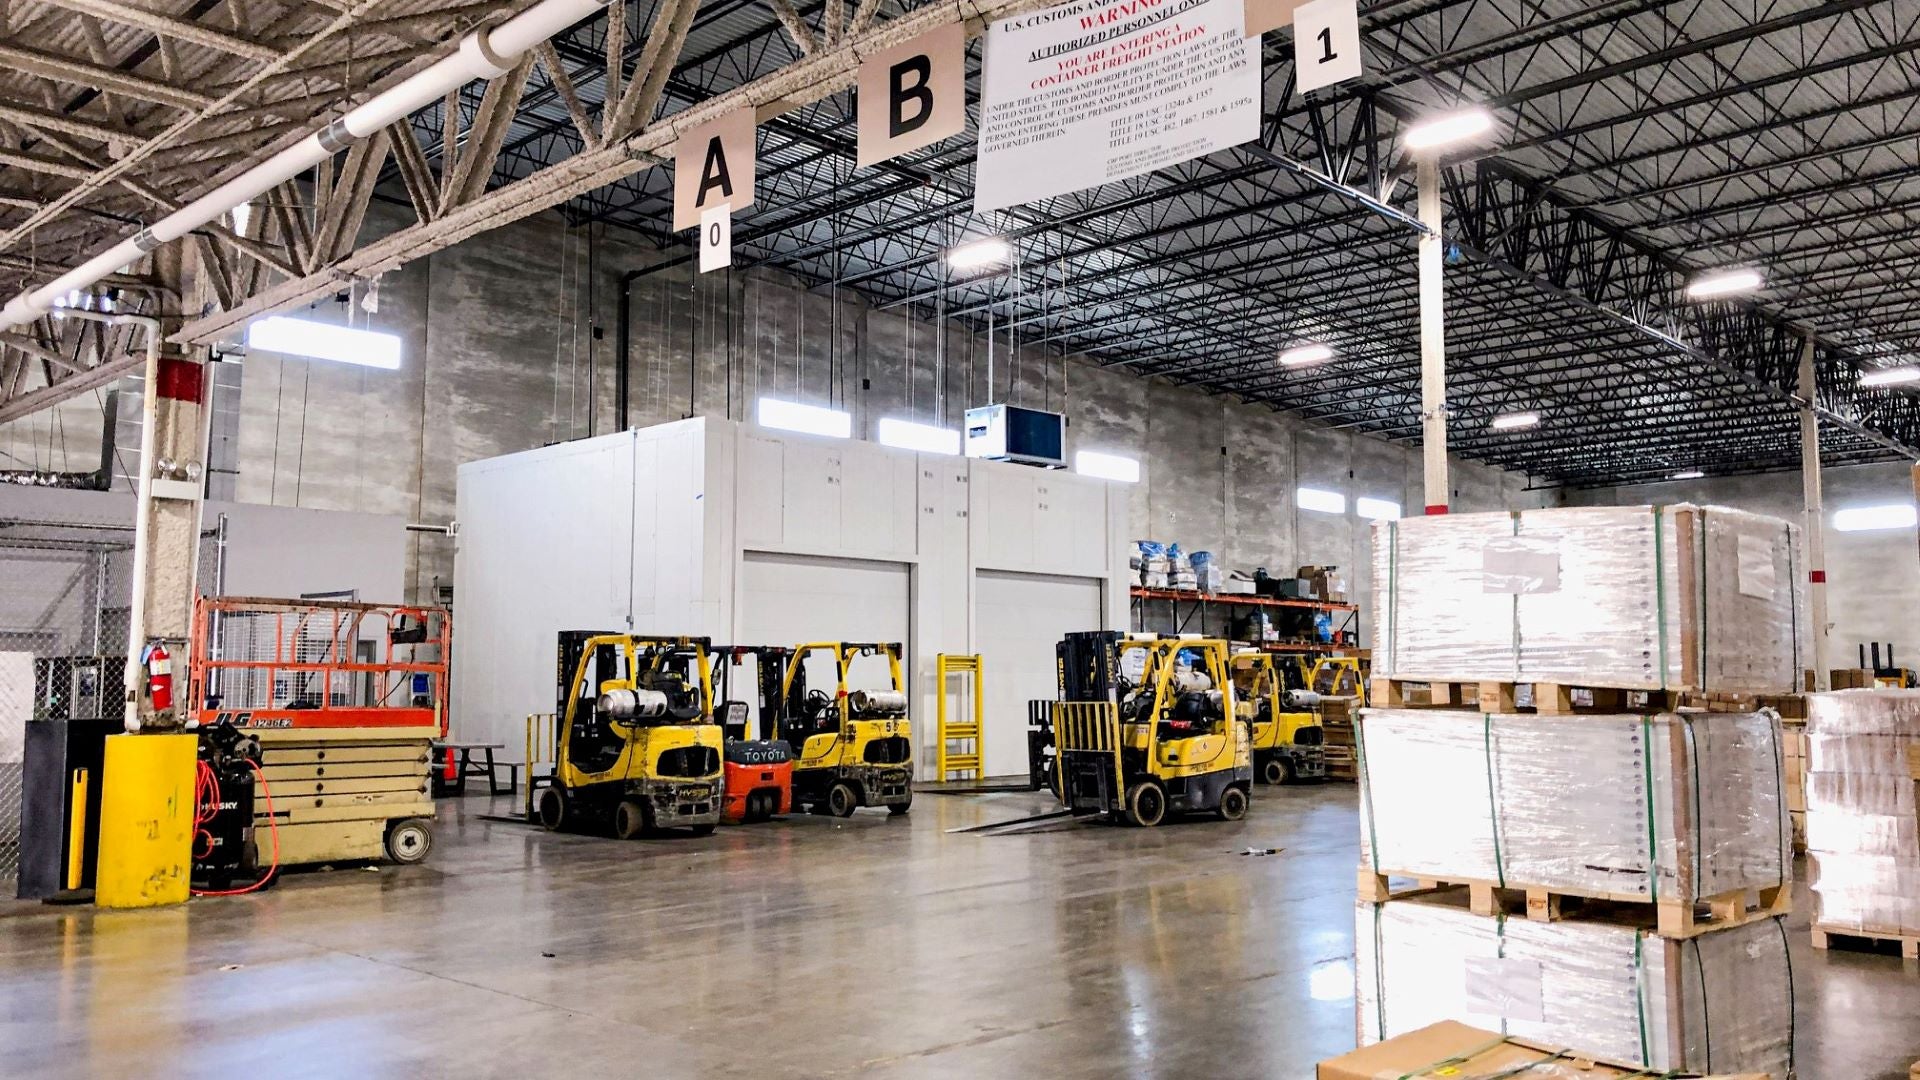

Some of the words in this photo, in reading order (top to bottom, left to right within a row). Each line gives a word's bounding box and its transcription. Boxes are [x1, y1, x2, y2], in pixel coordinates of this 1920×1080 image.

[1005, 22, 1025, 32] U.S.
[1027, 5, 1083, 27] CUSTOMS
[1086, 0, 1110, 10] AND
[1029, 31, 1106, 61] AUTHORIZED
[1109, 6, 1174, 39] PERSONNEL
[1178, 0, 1210, 12] ON
[1031, 63, 1099, 90] CONTAINER
[1102, 46, 1153, 71] FREIGHT
[1156, 23, 1207, 52] STATION
[1058, 56, 1083, 71] YOU
[1086, 48, 1107, 63] ARE
[1110, 27, 1172, 55] ENTERING
[1174, 23, 1182, 33] A
[1317, 27, 1337, 64] 1
[986, 100, 1015, 114] UNDER
[1016, 97, 1032, 107] THE
[1034, 87, 1073, 103] CUSTOMS
[1075, 80, 1093, 93] AND
[1094, 70, 1128, 87] BORDER
[1130, 51, 1182, 75] PROTECTION
[1183, 43, 1207, 56] LAWS
[1208, 35, 1219, 47] OF
[1221, 28, 1237, 41] THE
[986, 110, 1017, 124] UNITED
[1050, 97, 1070, 108] THIS
[1070, 86, 1106, 103] BONDED
[1107, 75, 1144, 93] FACILITY
[1145, 71, 1154, 80] IS
[1155, 60, 1184, 76] UNDER
[1186, 54, 1201, 65] THE
[1203, 37, 1244, 59] CUSTODY
[986, 122, 1004, 134] AND
[1005, 114, 1042, 129] CONTROL
[1044, 111, 1056, 120] OF
[1057, 101, 1097, 116] CUSTOMS
[1098, 94, 1117, 105] AND
[1118, 83, 1151, 100] BORDER
[1153, 63, 1206, 87] PROTECTION
[1208, 55, 1226, 68] AND
[1228, 46, 1247, 60] ANY
[889, 54, 933, 139] B
[985, 129, 1017, 144] PERSON
[1018, 120, 1059, 136] ENTERING
[1061, 112, 1086, 125] THESE
[1087, 101, 1128, 119] PREMISES
[1129, 91, 1152, 105] MUST
[1154, 80, 1188, 98] COMPLY
[1190, 75, 1202, 86] TO
[1204, 69, 1219, 81] THE
[1222, 59, 1248, 74] LAWS
[1110, 115, 1132, 128] TITLE
[1134, 110, 1144, 121] 08
[1145, 106, 1163, 117] USC
[1186, 95, 1194, 104] &
[1195, 87, 1214, 101] 1357
[984, 136, 1029, 154] GOVERNED
[1031, 127, 1066, 143] THEREIN
[1109, 135, 1131, 148] TITLE
[1134, 132, 1143, 142] 19
[1144, 126, 1161, 138] USC
[1201, 108, 1218, 121] 1581
[1219, 105, 1228, 114] &
[1110, 125, 1132, 138] TITLE
[1135, 121, 1144, 131] 18
[1145, 116, 1162, 128] USC
[695, 135, 733, 208] A
[1105, 643, 1115, 683] HYSTER
[210, 712, 252, 727] JLG
[744, 750, 786, 761] TOYOTA
[679, 788, 709, 796] HYSTER
